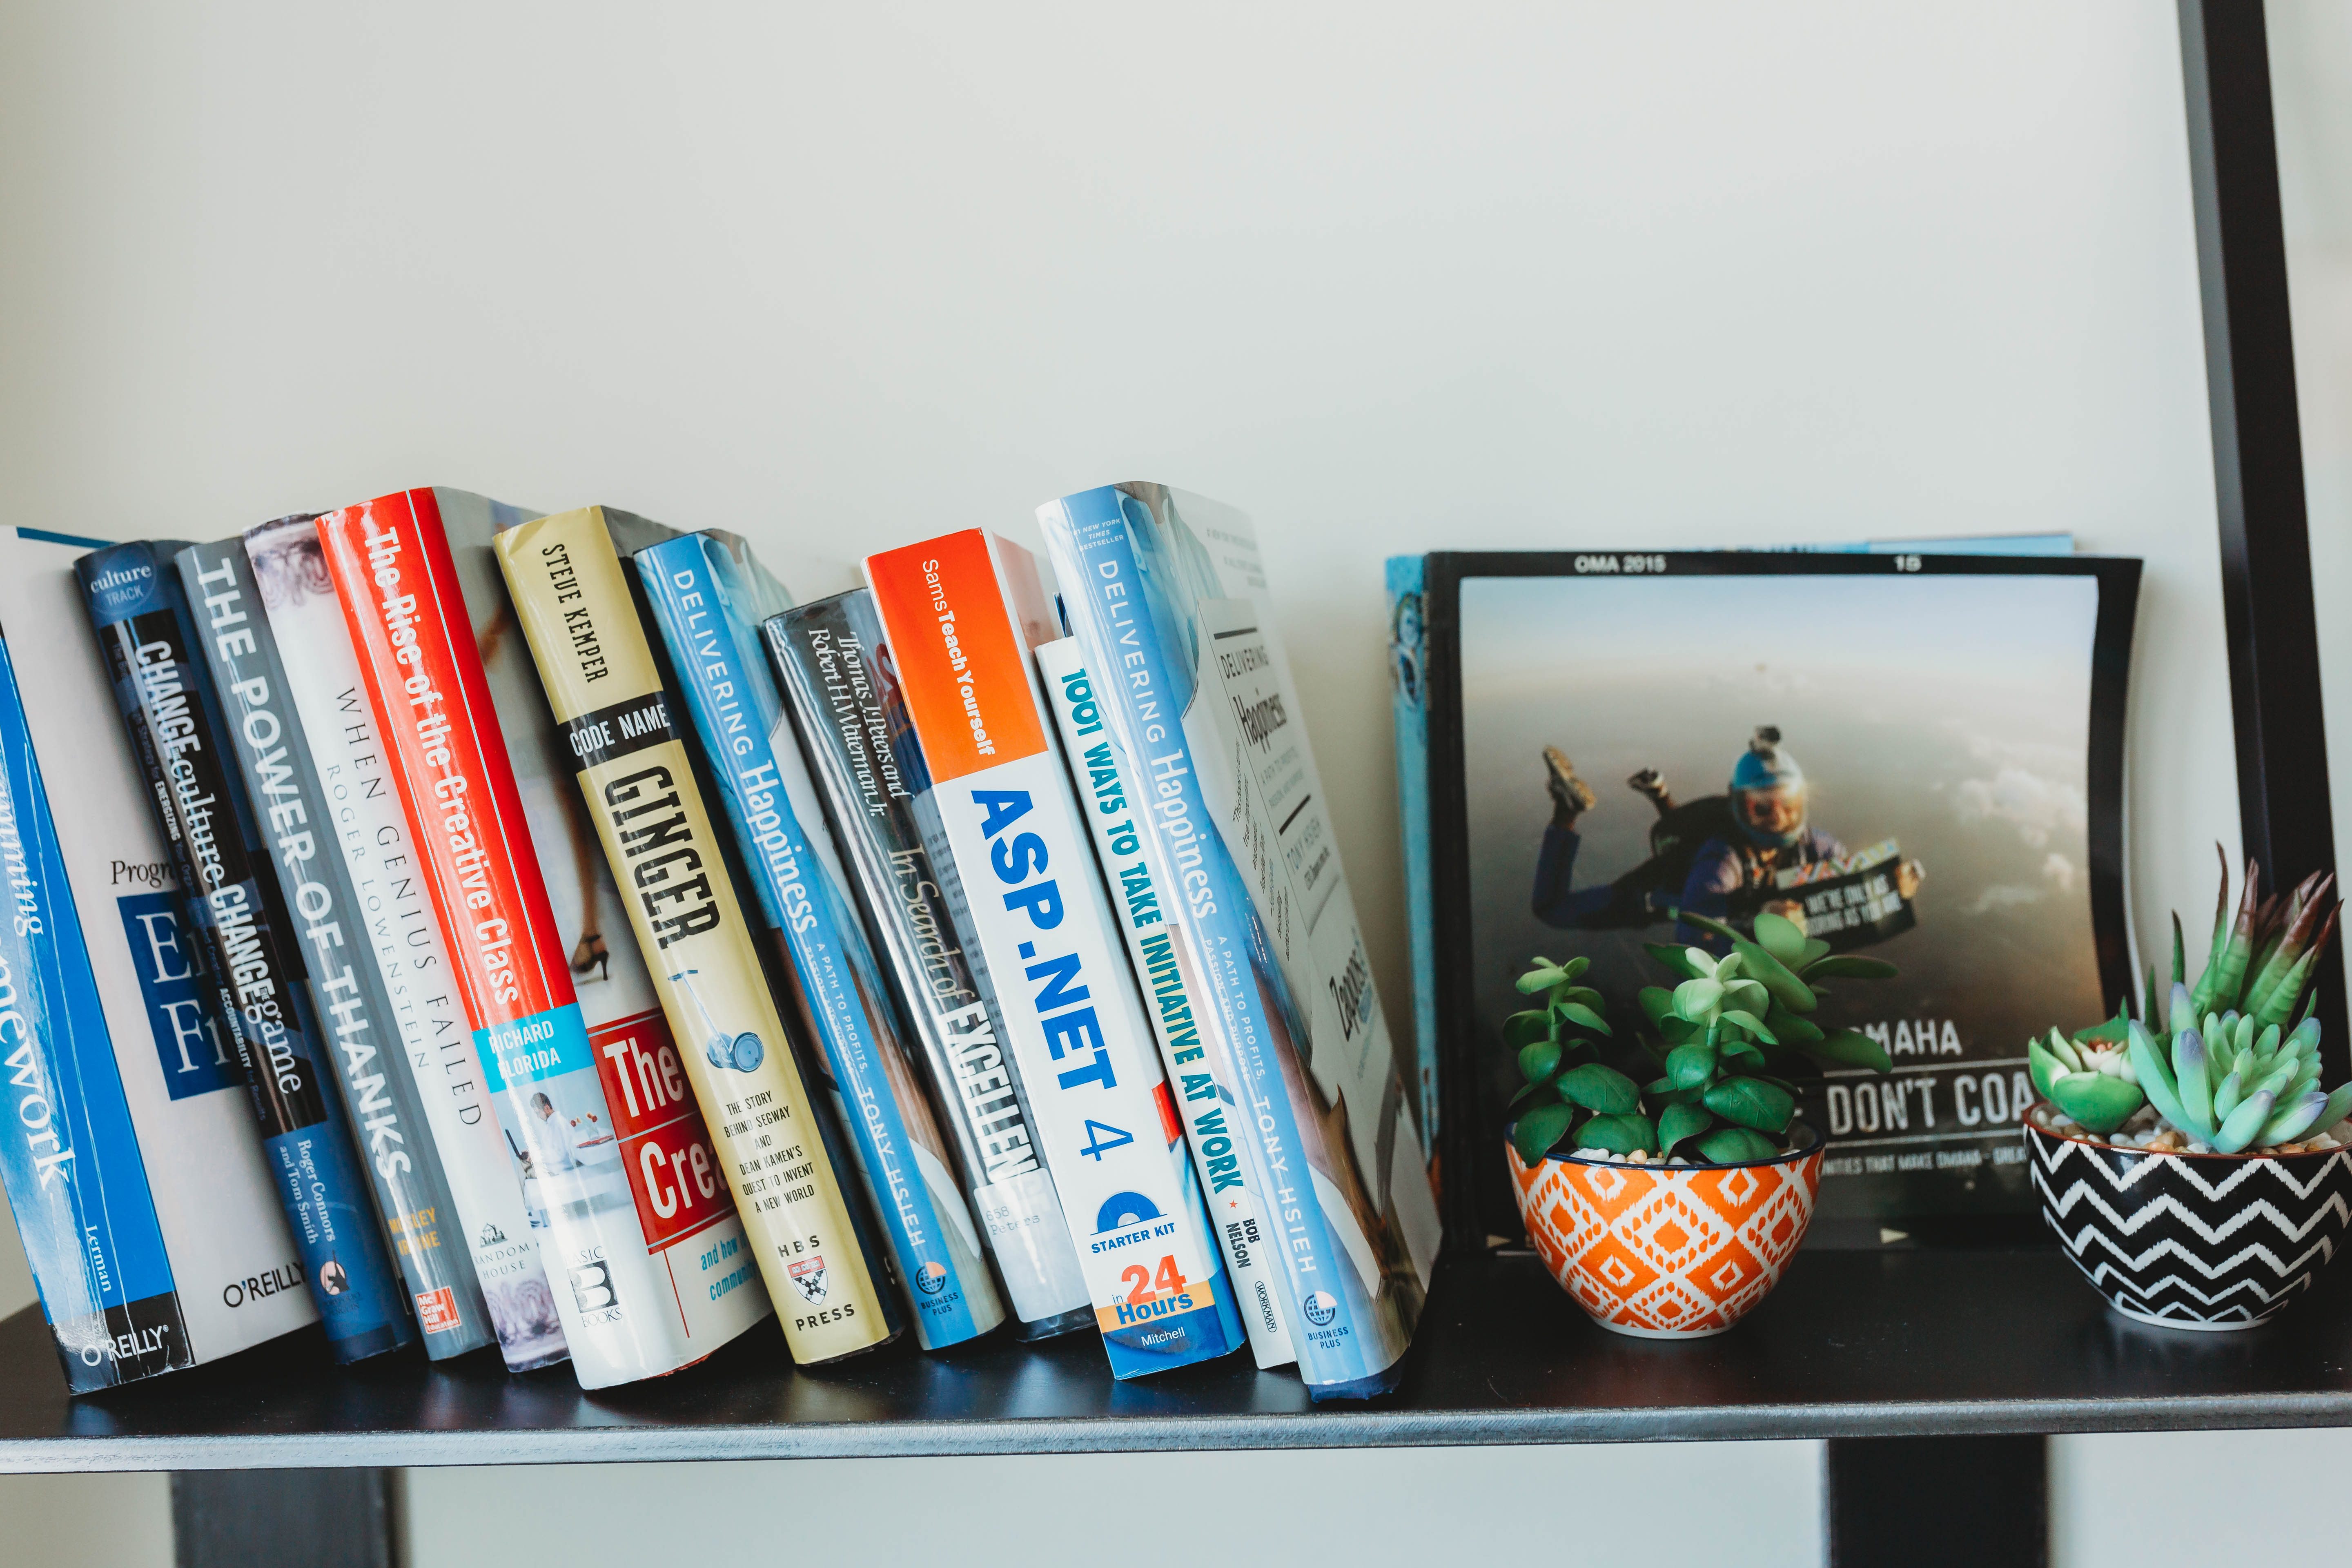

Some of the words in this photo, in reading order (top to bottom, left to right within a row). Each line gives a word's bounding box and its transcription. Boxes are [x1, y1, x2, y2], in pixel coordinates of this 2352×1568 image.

[1079, 535, 1123, 551] BESTSELLER
[1083, 523, 1099, 533] NEW
[1101, 518, 1120, 528] YORK
[1088, 529, 1110, 540] TIMES
[365, 526, 401, 588] The
[90, 564, 152, 593] culture
[105, 585, 144, 606] TRACK
[382, 594, 422, 666] Rise
[542, 543, 582, 604] STEVE
[564, 606, 608, 683] KEMPER
[808, 627, 842, 685] Robert
[922, 559, 947, 612] Sams
[938, 610, 968, 672] Teach
[957, 670, 996, 756] Yourself
[404, 675, 443, 706] of
[827, 684, 853, 706] H.
[1061, 668, 1103, 737] 1001
[570, 721, 615, 757] CODE
[617, 703, 671, 740] NAME
[837, 631, 872, 699] Thomas
[863, 711, 894, 764] Peters
[881, 764, 915, 800] and
[417, 713, 452, 768] the
[673, 569, 754, 756] DELIVERING
[740, 760, 817, 934] Happiness
[835, 704, 879, 800] Waterman
[1098, 560, 1166, 743] DELIVERING
[1150, 748, 1218, 919] Happiness
[1083, 742, 1128, 815] WAYS
[155, 780, 181, 841] ENERGIZING
[866, 799, 888, 817] Jr.
[434, 775, 491, 910] Creative
[1106, 819, 1140, 856] TO
[136, 640, 202, 760] CHANGE
[170, 759, 225, 883] culture
[209, 884, 275, 1004] CHANGE
[245, 1000, 301, 1094] game
[198, 557, 256, 662] THE
[231, 675, 315, 867] POWER
[295, 881, 344, 950] OF
[322, 964, 411, 1180] THANKS
[604, 765, 721, 950] GINGER
[887, 843, 925, 878] In
[336, 686, 386, 800] WHEN
[377, 826, 437, 969] GENIUS
[426, 993, 481, 1125] FAILED
[1119, 861, 1164, 929] TAKE
[327, 764, 366, 862] ROGER
[362, 879, 429, 1069] LOWENSTEIN
[900, 880, 962, 973] Search
[1218, 936, 1227, 946] A
[476, 918, 518, 1007] Class
[971, 791, 1118, 1090] ASP.NET
[1080, 1119, 1134, 1162] 4
[1222, 951, 1240, 987] PATH
[932, 978, 976, 1000] of
[1140, 933, 1205, 1066] INITIATIVE
[1234, 991, 1246, 1011] TO
[817, 943, 826, 952] A
[822, 956, 840, 989] PATH
[835, 993, 846, 1011] TO
[842, 1015, 868, 1073] PROFITS,
[219, 987, 252, 1068] ACCOUNTABILITY
[488, 1020, 554, 1054] RICHARD
[1221, 997, 1234, 1022] AND
[1231, 1026, 1251, 1081] PURPOSE
[1854, 1020, 1963, 1056] MAHA
[498, 1047, 561, 1080] FLORIDA
[1241, 1016, 1265, 1080] PROFITS,
[604, 1038, 684, 1118] The
[938, 1000, 1039, 1185] EXCELLEN
[1180, 1073, 1218, 1102] AT
[726, 1101, 742, 1115] THE
[745, 1091, 773, 1109] STORY
[1826, 1076, 1938, 1136] DON'T
[1954, 1071, 2036, 1126] COA
[724, 1120, 753, 1138] BEHIND
[756, 1106, 791, 1127] SEGWAY
[755, 1134, 772, 1150] AND
[1194, 1109, 1244, 1195] WORK
[739, 1159, 761, 1176] DEAN
[763, 1145, 803, 1168] KAMEN'S
[858, 1087, 895, 1156] TONY
[885, 1169, 925, 1247] HSIEH
[1898, 1152, 1934, 1171] MAKE
[279, 1146, 295, 1169] and
[288, 1168, 303, 1201] Tom
[297, 1201, 319, 1245] Smith
[298, 1139, 318, 1180] Roger
[311, 1182, 336, 1243] Connors
[742, 1178, 766, 1196] QUEST
[768, 1174, 780, 1188] TO
[783, 1162, 814, 1183] INVENT
[1252, 1095, 1287, 1172] TONY
[1278, 1187, 1316, 1273] HSIEH
[755, 1202, 762, 1213] A
[763, 1195, 781, 1211] NEW
[784, 1185, 814, 1204] WORLD
[986, 1205, 1010, 1221] 658
[388, 1207, 436, 1234] MOSLEY
[990, 1214, 1040, 1236] Peters
[1091, 1230, 1151, 1254] STARTER
[1154, 1222, 1175, 1237] KIT
[1243, 1218, 1261, 1243] BOB
[85, 1224, 111, 1293] Lerman
[397, 1230, 441, 1256] IRVINE
[474, 1243, 530, 1265] RANDOM
[701, 1243, 719, 1271] and
[719, 1236, 738, 1260] how
[1226, 1222, 1252, 1269] NELSON
[483, 1260, 526, 1280] HOUSE
[1112, 1294, 1124, 1305] in
[1121, 1254, 1187, 1306] 24
[419, 1294, 434, 1306] Mc
[421, 1303, 445, 1315] Graw
[581, 1307, 623, 1327] BOOKS
[795, 1304, 855, 1331] PRESS
[920, 1292, 959, 1310] BUSINESS
[932, 1305, 952, 1317] PLUS
[1116, 1293, 1193, 1325] Hours
[1256, 1284, 1276, 1330] WORKMAN
[1141, 1326, 1185, 1347] Mitchell
[1307, 1327, 1348, 1341] BUSINESS
[1320, 1339, 1341, 1349] PLUS
